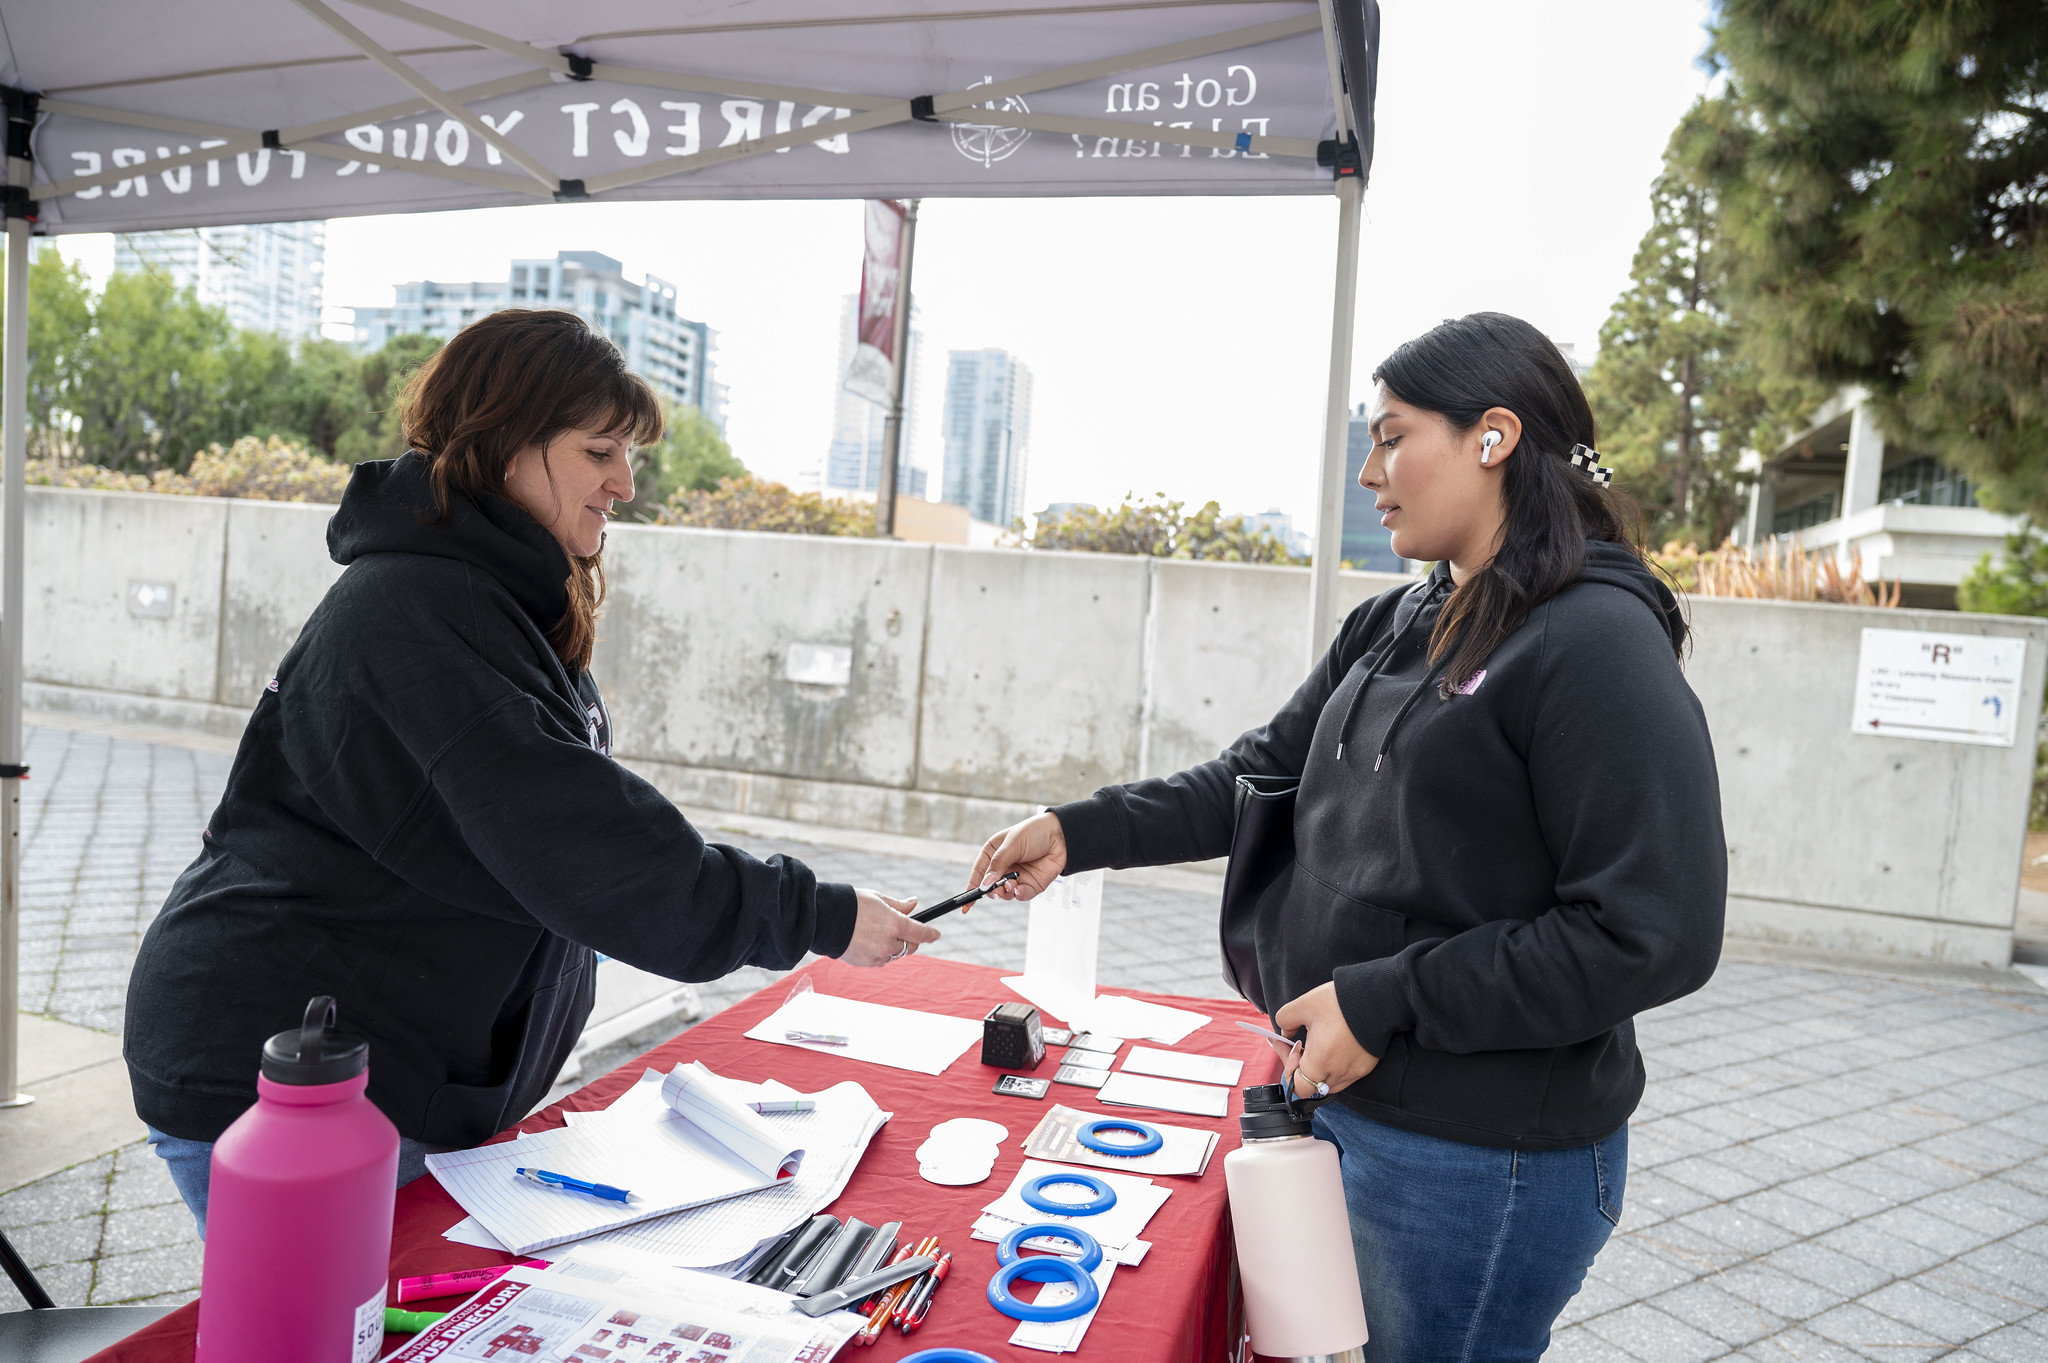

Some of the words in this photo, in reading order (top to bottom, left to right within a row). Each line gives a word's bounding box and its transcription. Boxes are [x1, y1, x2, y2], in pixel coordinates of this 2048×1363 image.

[404, 1339, 449, 1363] PUS
[440, 1283, 523, 1340] DIRECTORY
[398, 1344, 416, 1361] SAN
